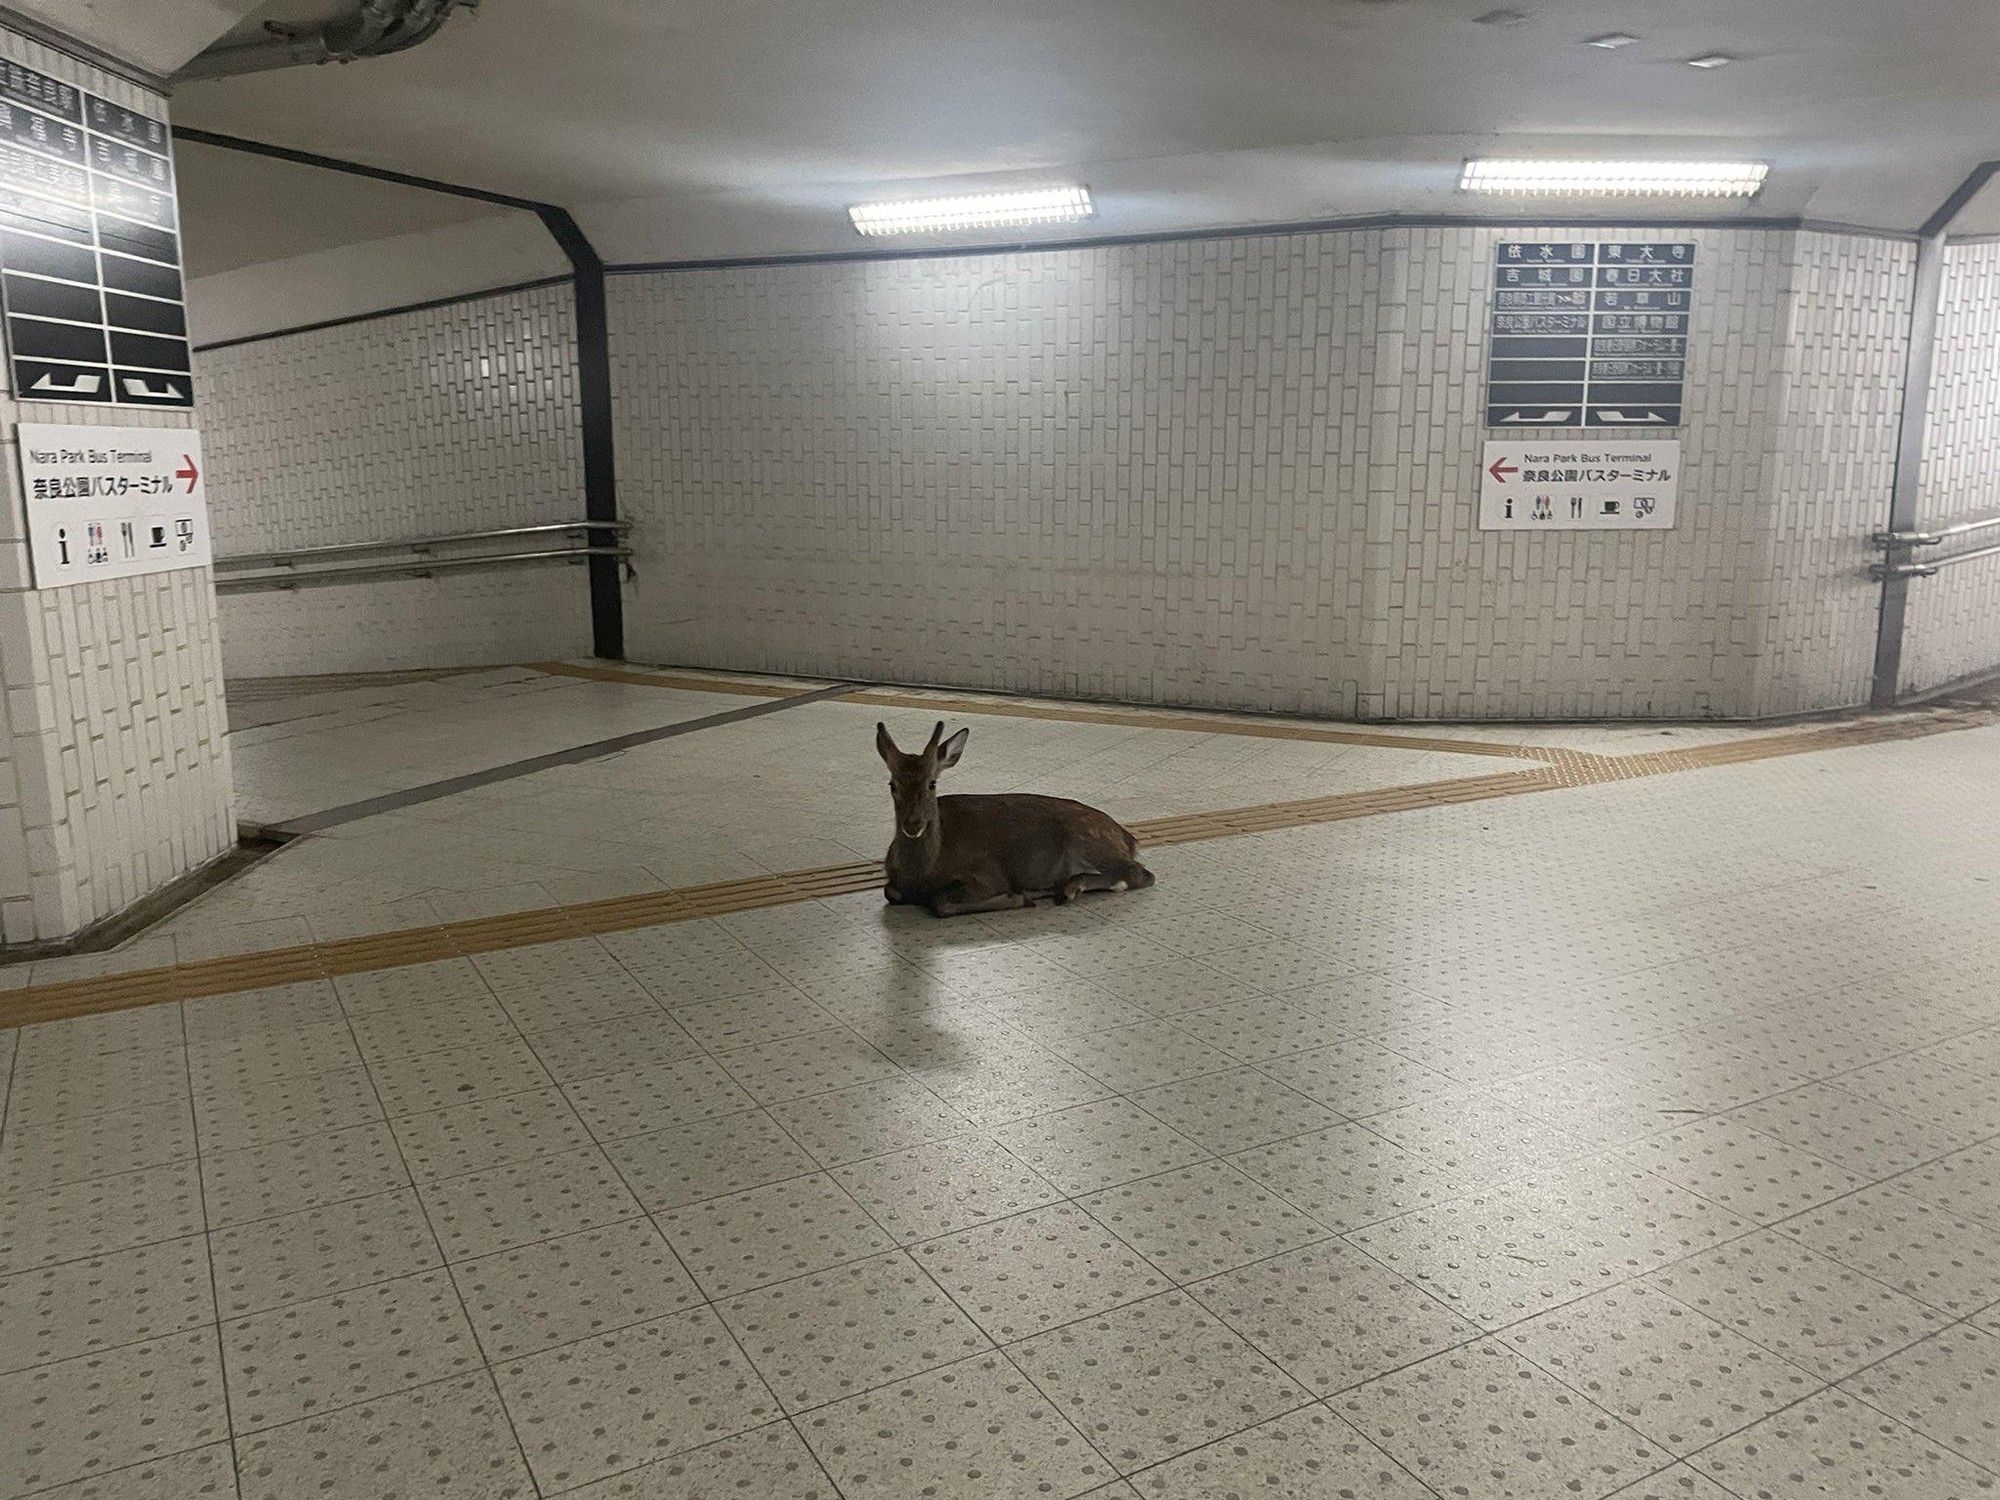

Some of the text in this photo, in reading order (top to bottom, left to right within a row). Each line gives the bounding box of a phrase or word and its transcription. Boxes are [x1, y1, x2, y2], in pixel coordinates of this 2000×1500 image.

[1608, 245, 1685, 259] 東大寺
[1606, 269, 1684, 282] 春日大社
[1602, 315, 1679, 329] 国立博物館
[29, 449, 152, 464] Nara Park Bus Terminal
[1524, 453, 1652, 463] Nara Park Bus Terminal
[1522, 469, 1671, 482] 奈良公園バスターミナル
[33, 475, 173, 500] 奈良公園バスターミナル
